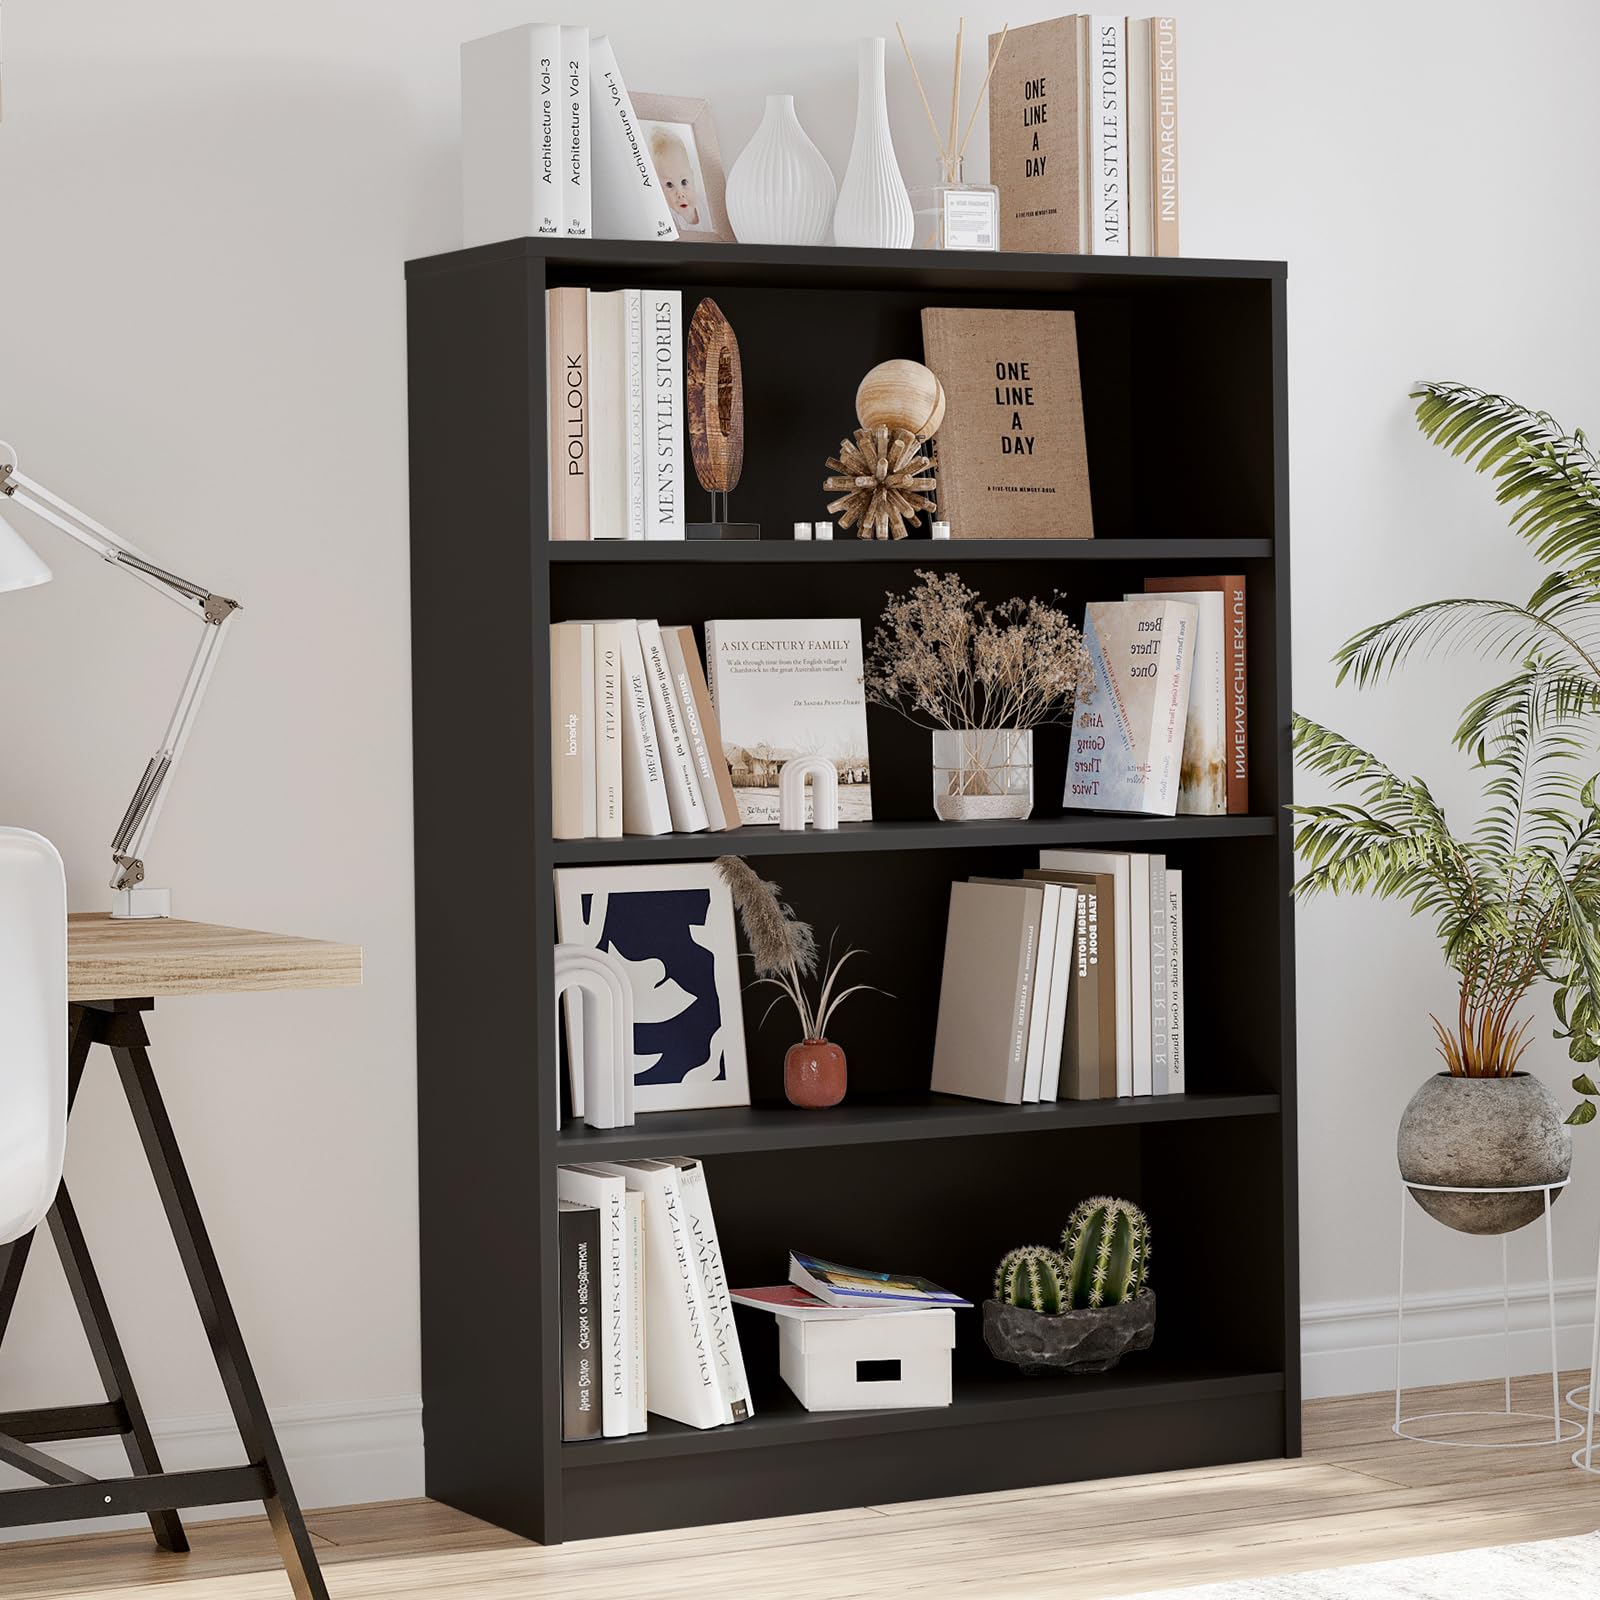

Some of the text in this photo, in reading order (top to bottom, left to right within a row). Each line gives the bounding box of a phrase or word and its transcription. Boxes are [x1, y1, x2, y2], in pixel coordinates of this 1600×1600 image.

[1025, 78, 1046, 100] ONE
[541, 58, 552, 184] Architecture Vol-3
[569, 61, 580, 186] Architecture Vol-2
[604, 72, 652, 187] Architecture Vol-1
[1024, 104, 1047, 127] LINE
[1102, 26, 1119, 243] MEN'S STYLE STORIES
[1160, 18, 1176, 221] INNENARCHITEKTUR
[1032, 132, 1039, 151] A
[1025, 157, 1047, 178] DAY
[631, 296, 641, 398] REVOLUTION
[996, 362, 1030, 380] ONE
[567, 354, 584, 475] POLLOCK
[656, 302, 674, 524] MEN'S STYLE STORIES
[995, 387, 1034, 405] LINE
[632, 403, 641, 446] LOOK
[1011, 412, 1022, 430] A
[1001, 436, 1035, 455] DAY
[631, 452, 641, 486] NEW
[721, 640, 850, 651] A SIX CENTURY FAMILY
[578, 1316, 590, 1350] Сказки
[613, 1292, 623, 1397] JOHANNES
[684, 1283, 713, 1388] JOHANNES
